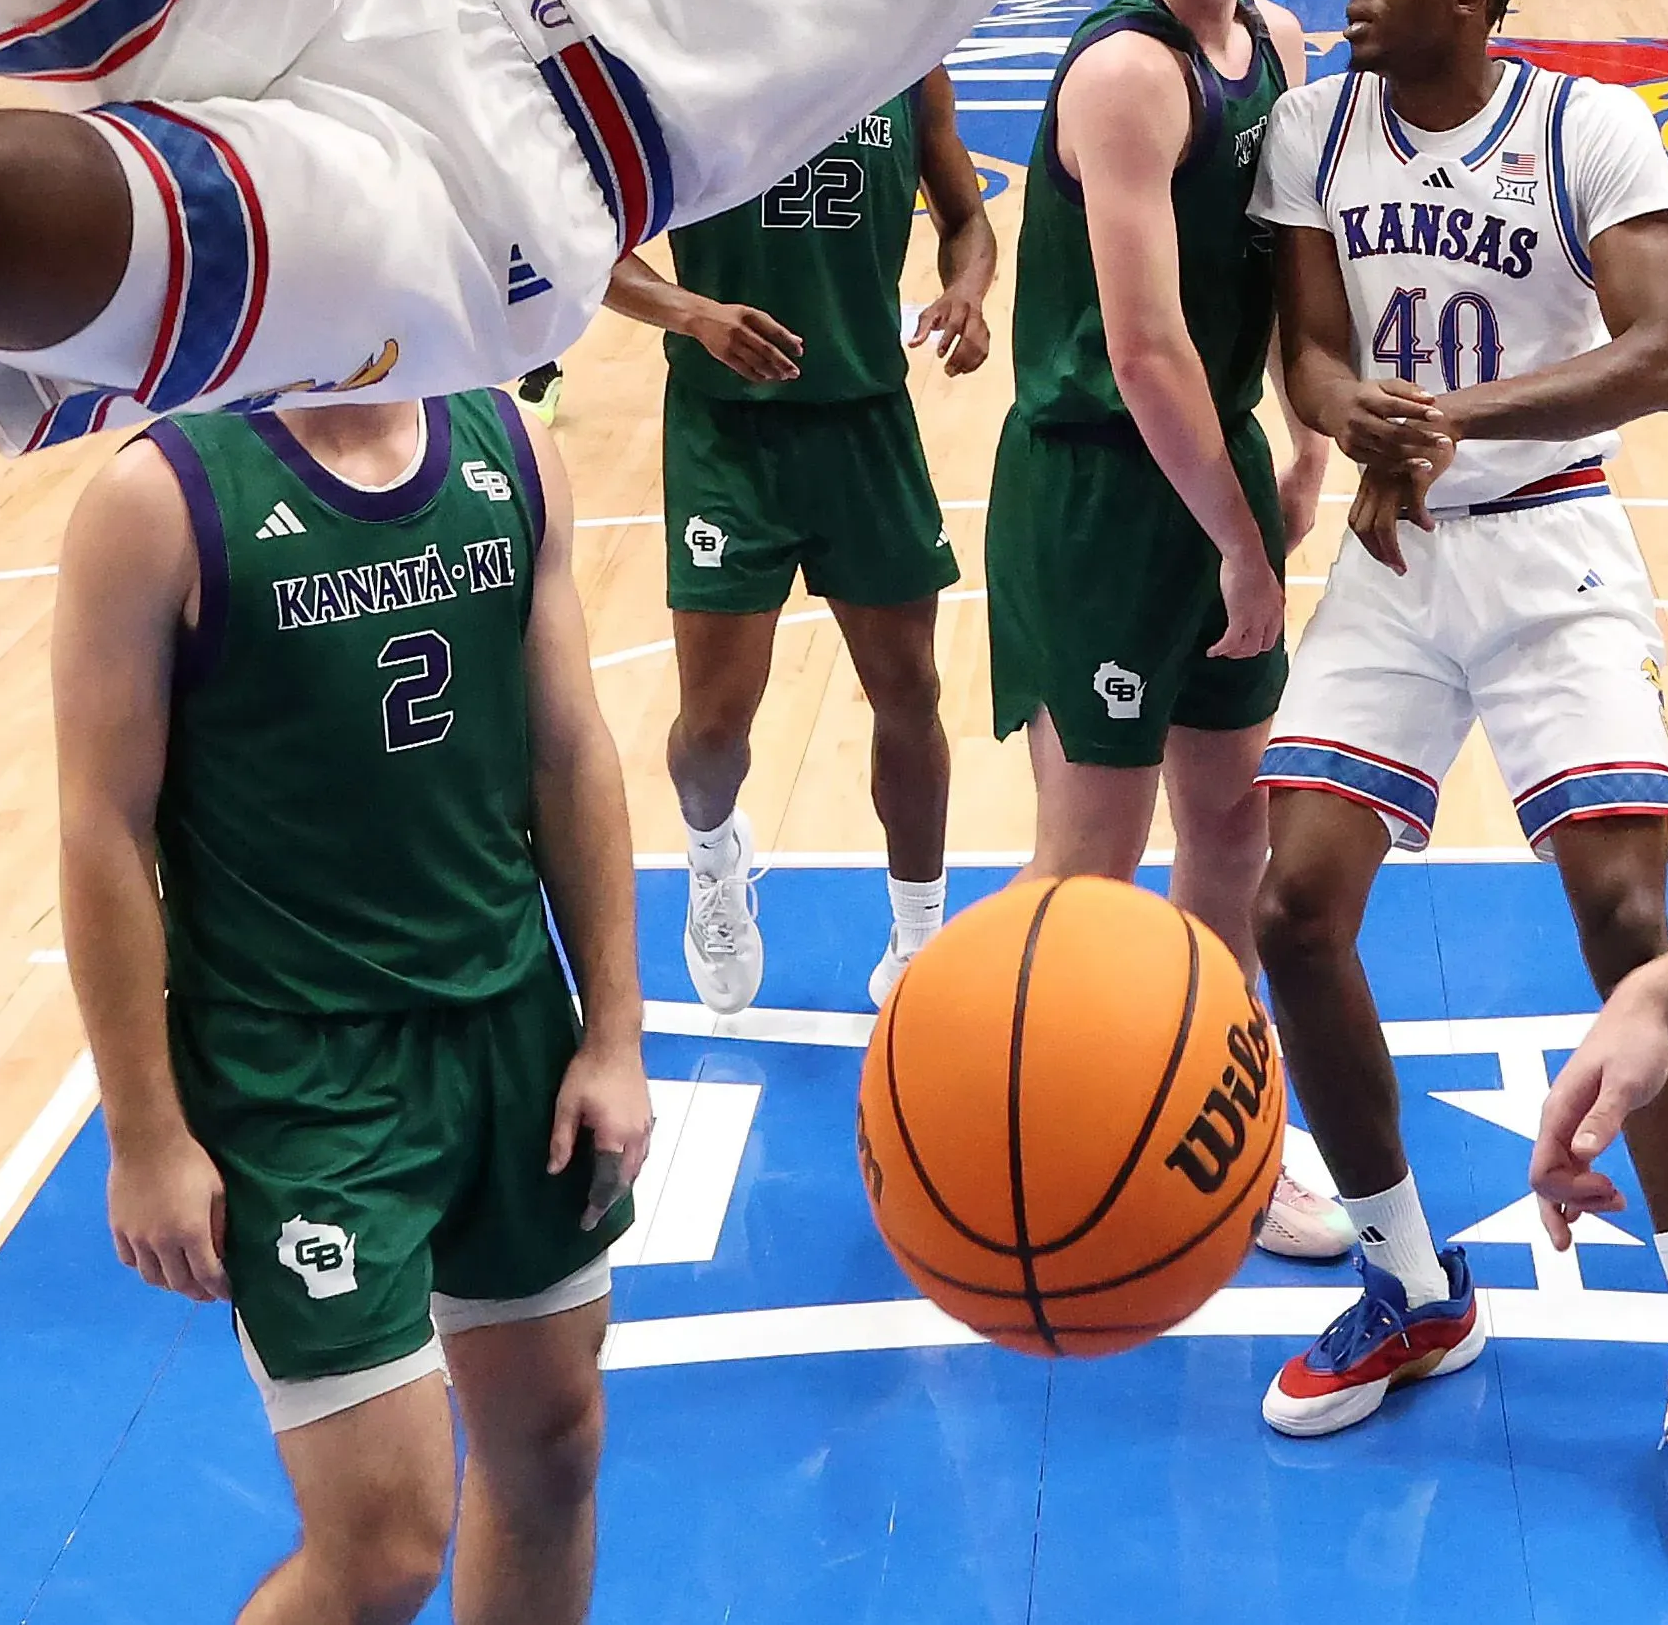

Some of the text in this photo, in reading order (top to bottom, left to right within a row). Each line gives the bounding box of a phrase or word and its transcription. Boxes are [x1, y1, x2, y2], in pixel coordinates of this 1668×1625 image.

[761, 157, 864, 230] 22
[1339, 201, 1538, 279] KANSAS
[1372, 286, 1503, 392] 40
[461, 459, 513, 502] GB
[377, 629, 455, 754] 2
[294, 1235, 345, 1273] GB
